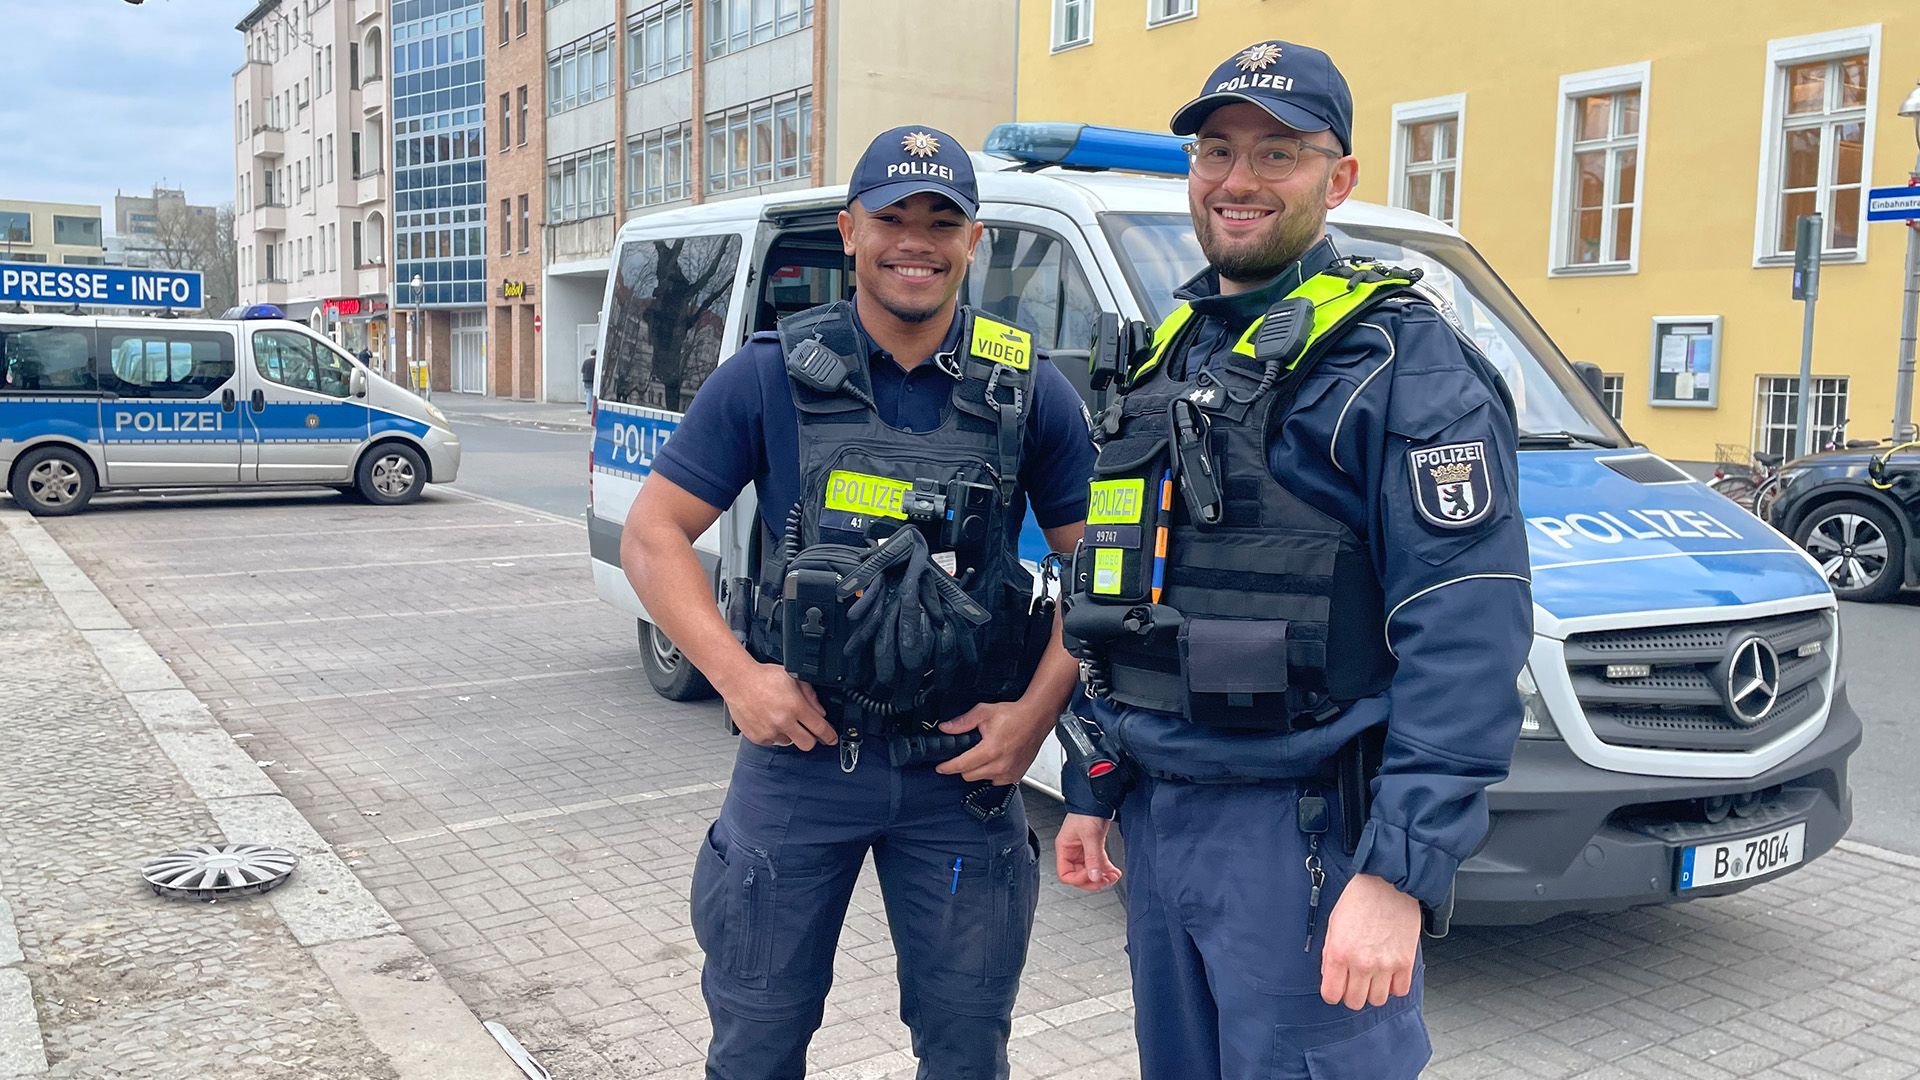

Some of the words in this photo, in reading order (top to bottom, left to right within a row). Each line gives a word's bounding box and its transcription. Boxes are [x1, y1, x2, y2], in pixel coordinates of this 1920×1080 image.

[1215, 73, 1294, 92] POLIZEI
[887, 161, 953, 180] POLIZEI
[2, 269, 109, 299] PRESSE
[131, 275, 190, 302] INFO
[978, 337, 1024, 365] VIDEO
[115, 411, 223, 432] POLIZEI
[1415, 446, 1481, 468] POLIZEI
[832, 478, 902, 512] POLIZE
[1091, 488, 1138, 516] POLIZEI
[1096, 530, 1118, 543] 99747
[1525, 509, 1745, 549] POLIZEI
[1714, 847, 1730, 879] B
[1745, 832, 1789, 873] 7804
[1682, 872, 1690, 882] D
